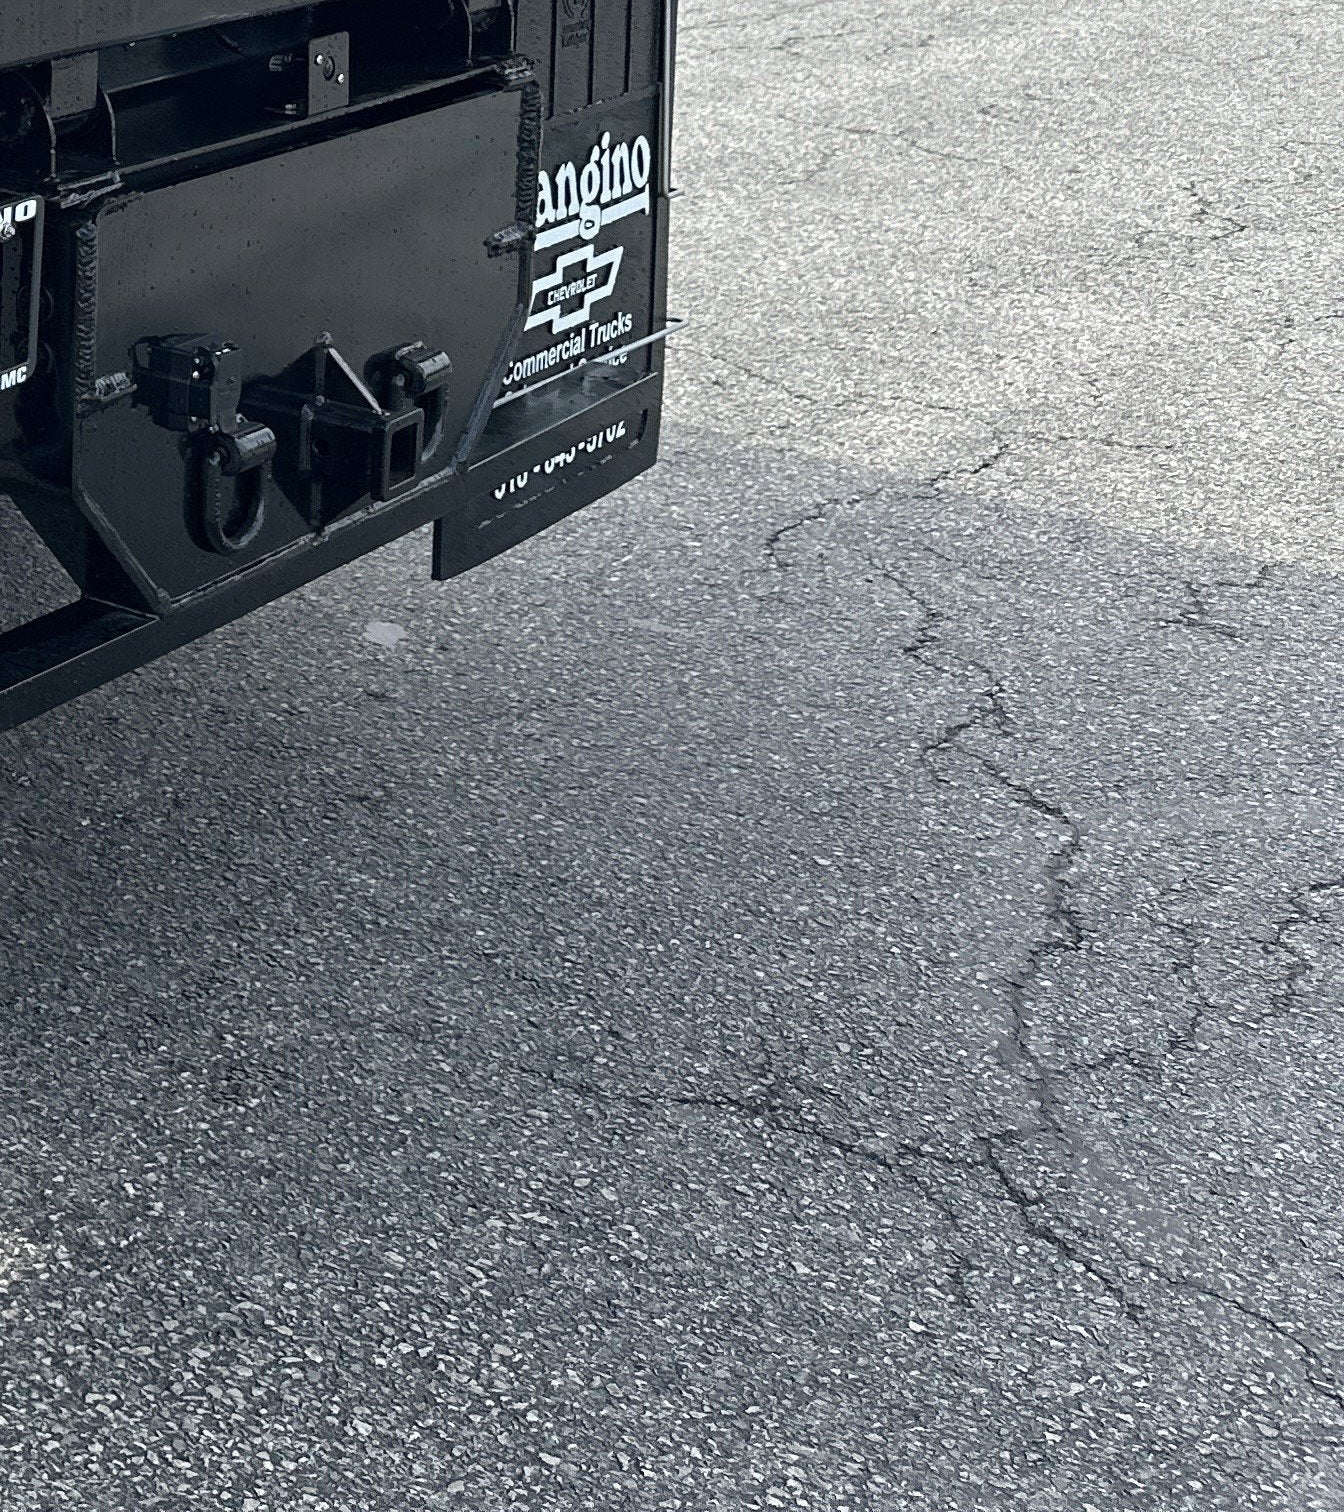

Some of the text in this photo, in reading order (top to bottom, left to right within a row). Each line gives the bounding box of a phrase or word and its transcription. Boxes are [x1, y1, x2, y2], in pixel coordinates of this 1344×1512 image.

[534, 131, 651, 245] angino
[546, 273, 598, 306] CHEVROLET
[588, 311, 633, 349] Trucks
